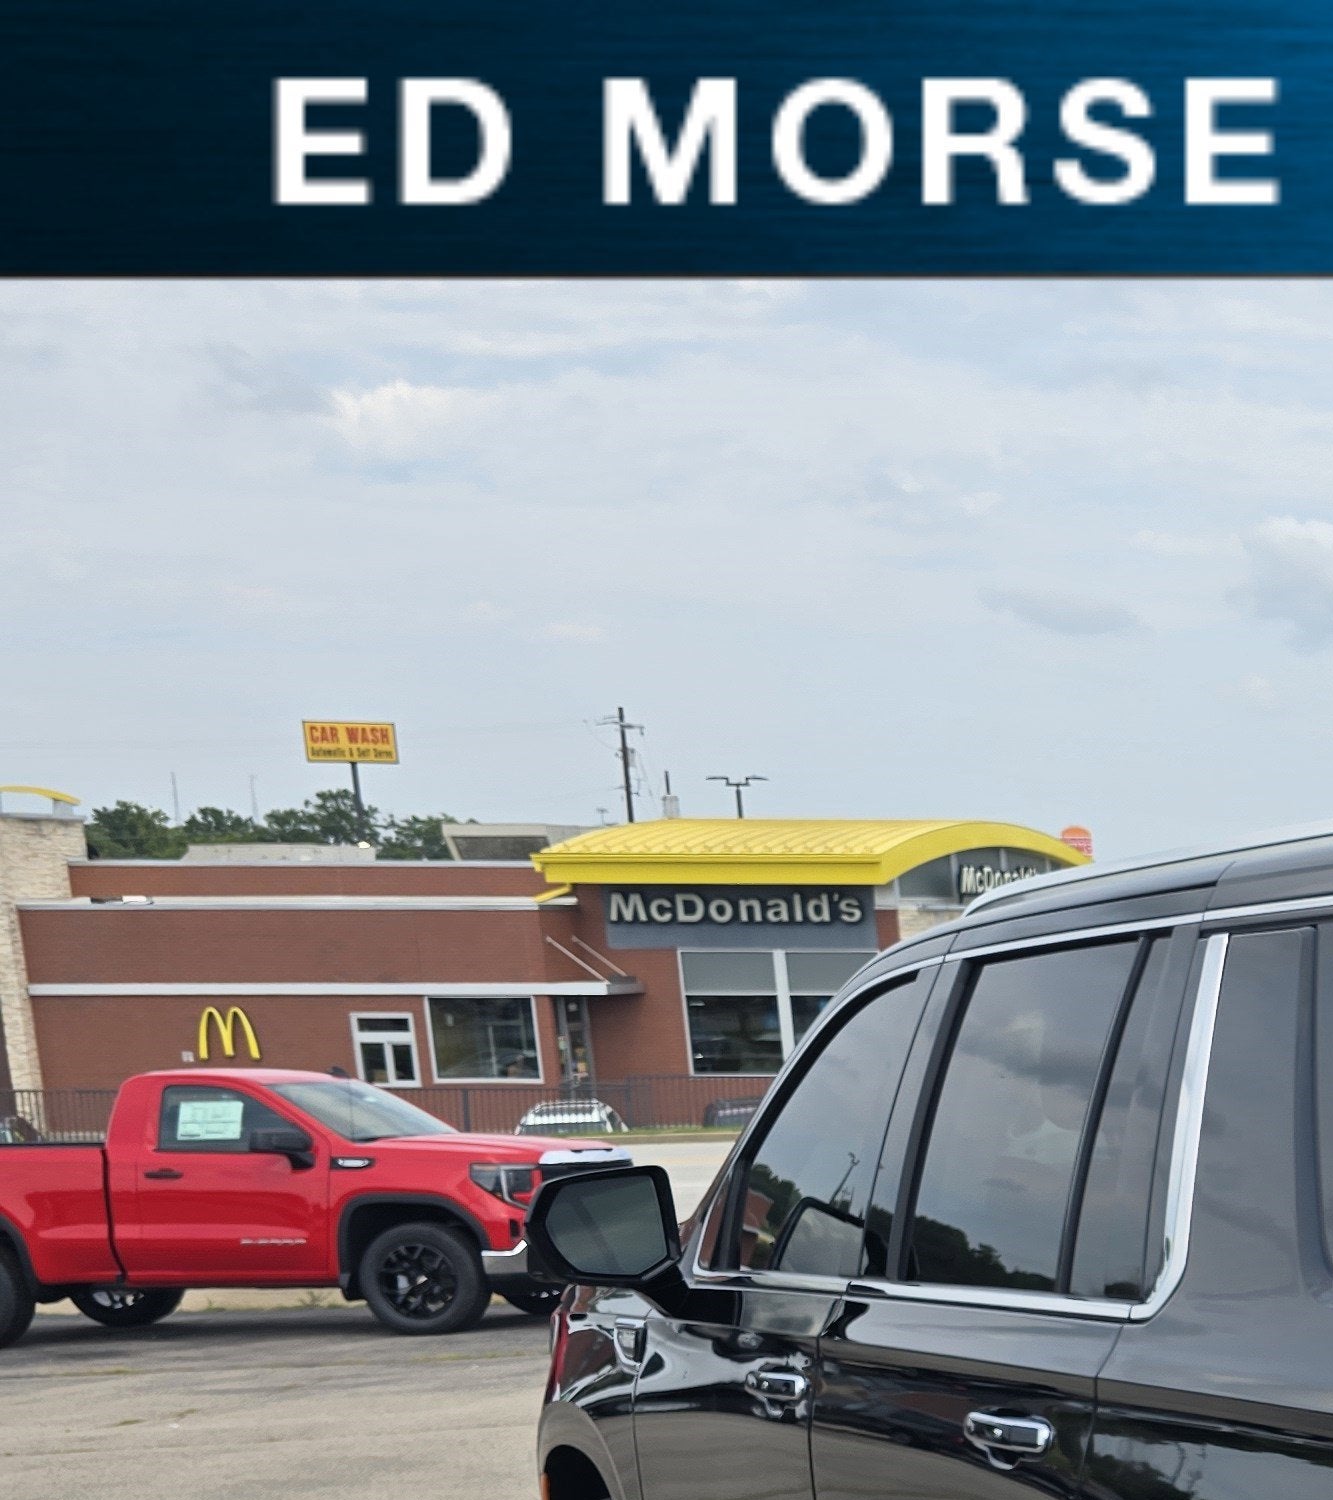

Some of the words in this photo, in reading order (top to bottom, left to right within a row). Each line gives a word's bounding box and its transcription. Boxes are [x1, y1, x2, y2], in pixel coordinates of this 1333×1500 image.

[309, 726, 340, 745] CAR
[345, 726, 390, 745] WASH
[609, 892, 863, 924] McDonald's
